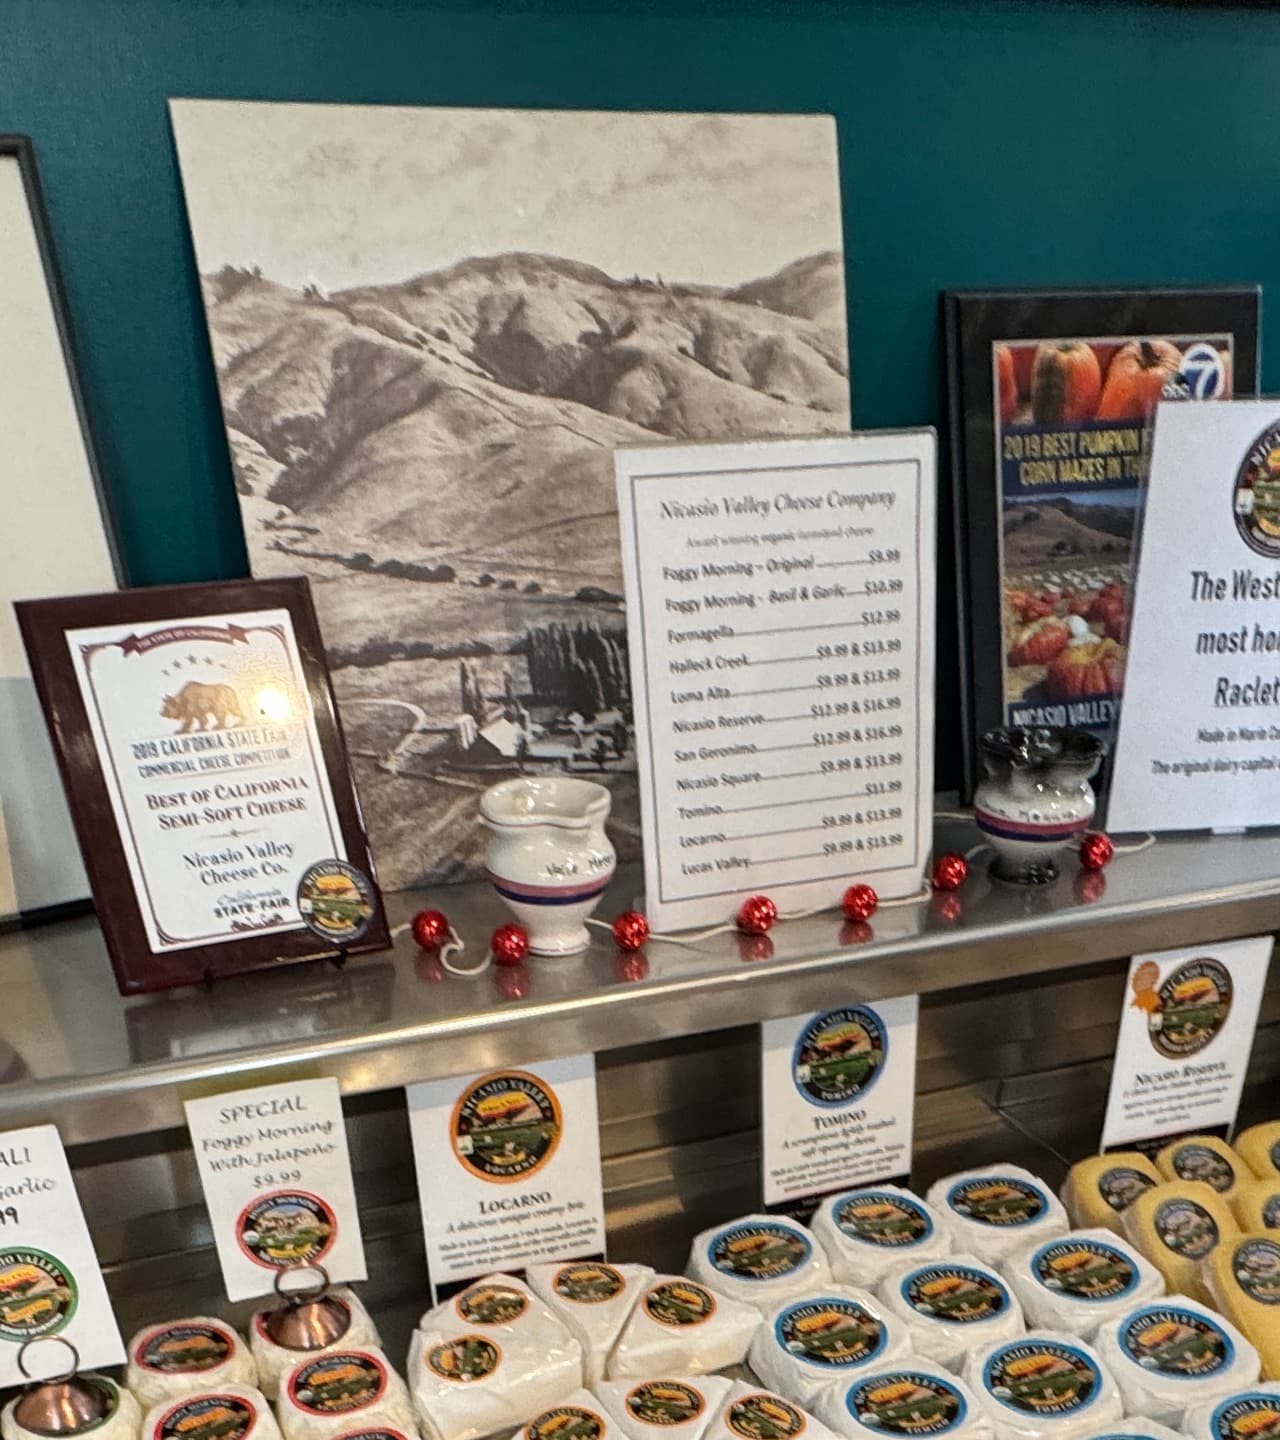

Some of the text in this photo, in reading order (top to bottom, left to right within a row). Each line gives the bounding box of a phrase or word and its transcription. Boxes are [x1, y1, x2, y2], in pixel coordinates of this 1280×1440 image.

[1004, 430, 1138, 460] 2019 BEST PUMPKIN
[1020, 459, 1121, 486] CORN MAZES IN
[659, 489, 896, 520] Nicasio Valley Cheese Company
[663, 554, 814, 583] Foggy Morning Original
[1191, 571, 1226, 602] The
[667, 625, 734, 645] Formagella
[1196, 628, 1246, 655] most
[671, 685, 730, 704] Loma Alta
[673, 710, 764, 735] Nicasio Reserve
[1012, 698, 1116, 728] NICASIO VALLEY
[145, 776, 309, 811] BEST OF CALIFORNIA
[158, 797, 307, 831] SEMI-SOFT CHEESE
[183, 841, 295, 871] Nicasio Valley
[200, 861, 288, 886] Cheese Co.
[219, 1096, 307, 1124] SPECIAL
[812, 1110, 867, 1130] TOMINO
[202, 1119, 334, 1152] Foggy Morning
[208, 1153, 251, 1172] With
[478, 1191, 552, 1215] LOCARNO
